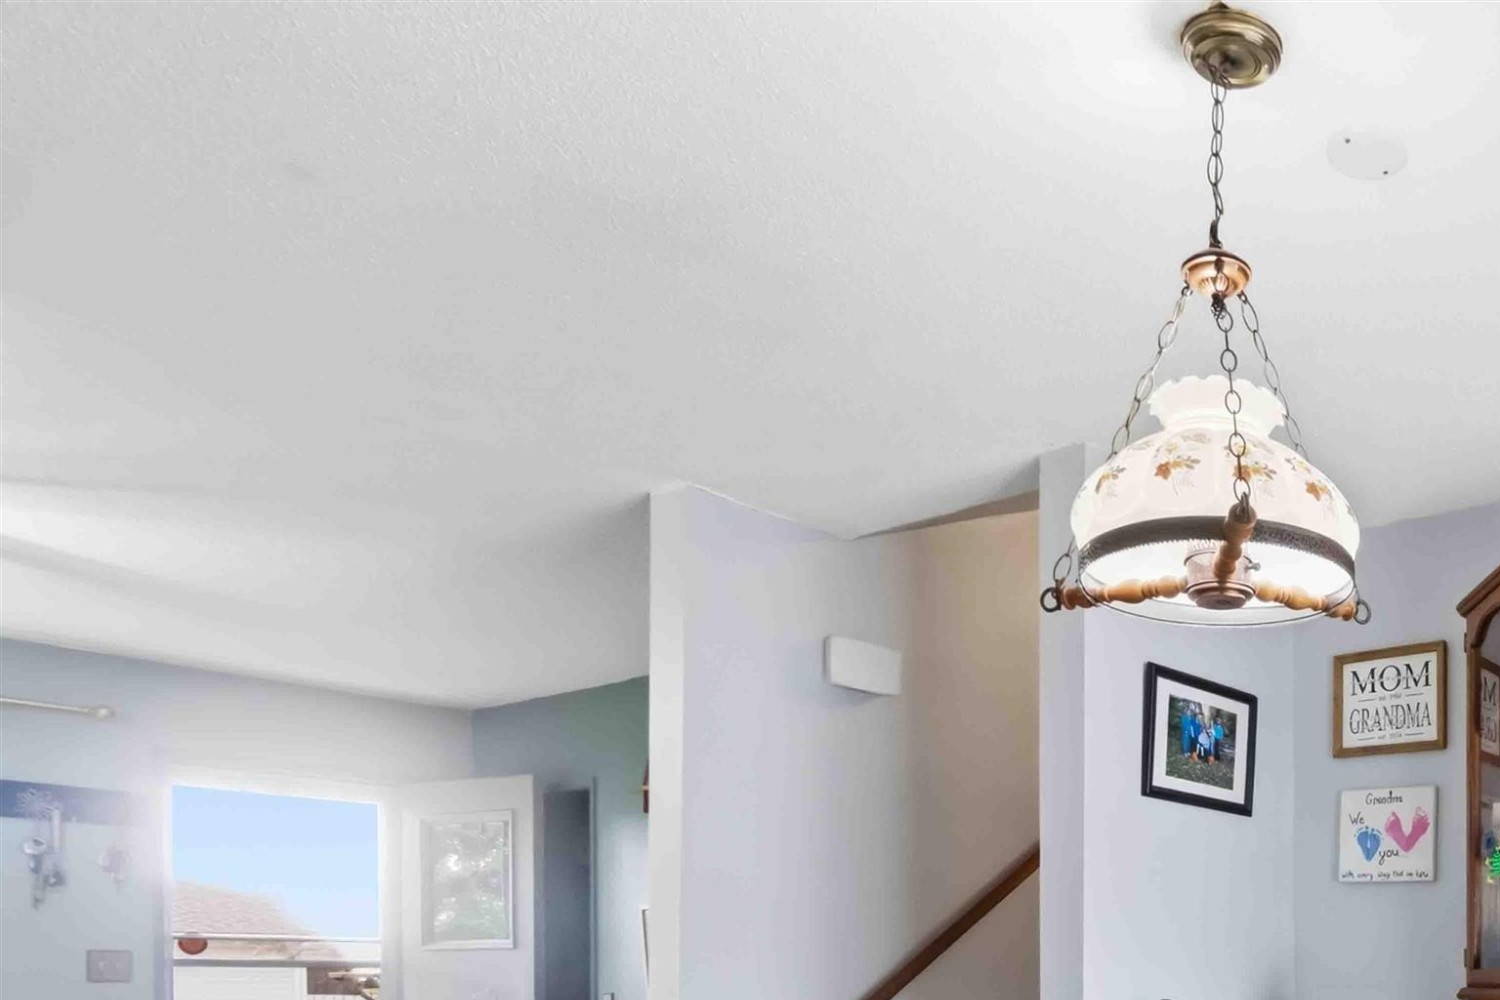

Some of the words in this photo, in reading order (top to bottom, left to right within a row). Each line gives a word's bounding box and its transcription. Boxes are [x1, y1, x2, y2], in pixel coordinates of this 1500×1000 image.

[1350, 660, 1432, 696] MOM
[1349, 701, 1432, 735] GRANDMA
[1348, 811, 1365, 825] We
[1378, 849, 1400, 866] you
